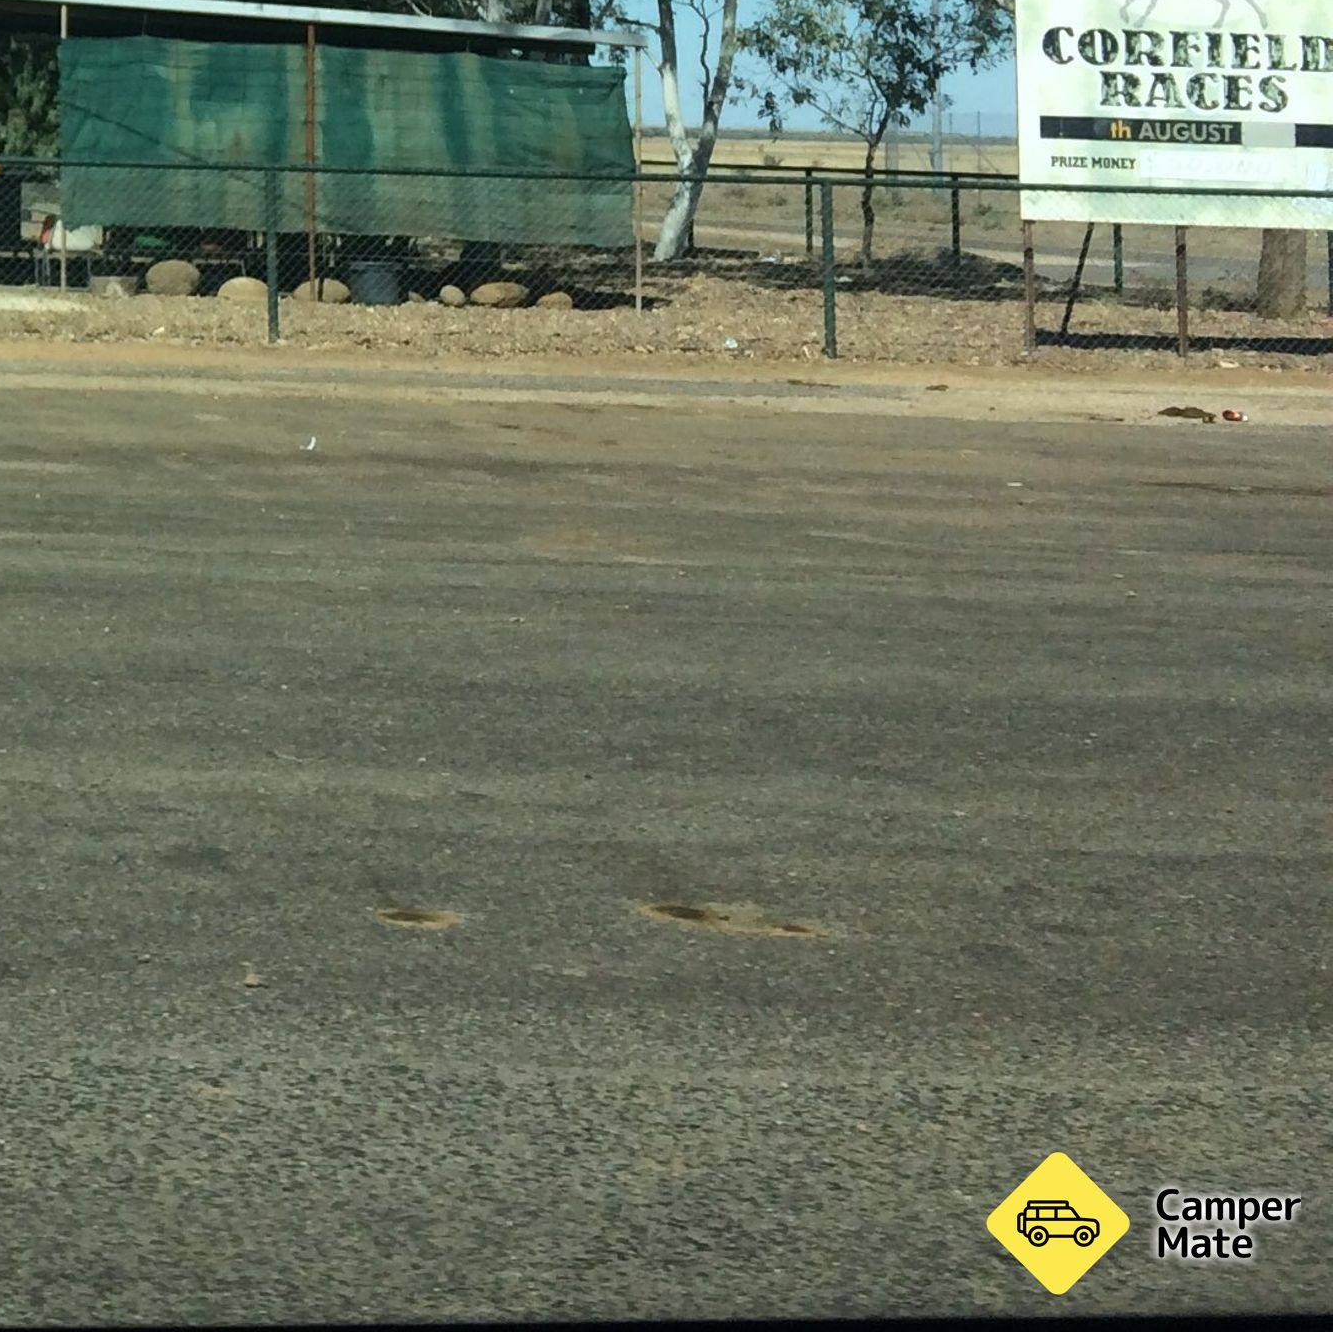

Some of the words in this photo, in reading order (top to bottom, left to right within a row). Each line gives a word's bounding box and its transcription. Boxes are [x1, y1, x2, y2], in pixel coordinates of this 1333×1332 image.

[1042, 26, 1333, 73] CORFIELD
[1100, 71, 1289, 113] RACES
[1109, 120, 1132, 139] th
[1138, 121, 1234, 143] AUGUST
[1050, 156, 1087, 169] PRIZE
[1091, 156, 1136, 170] MONEY
